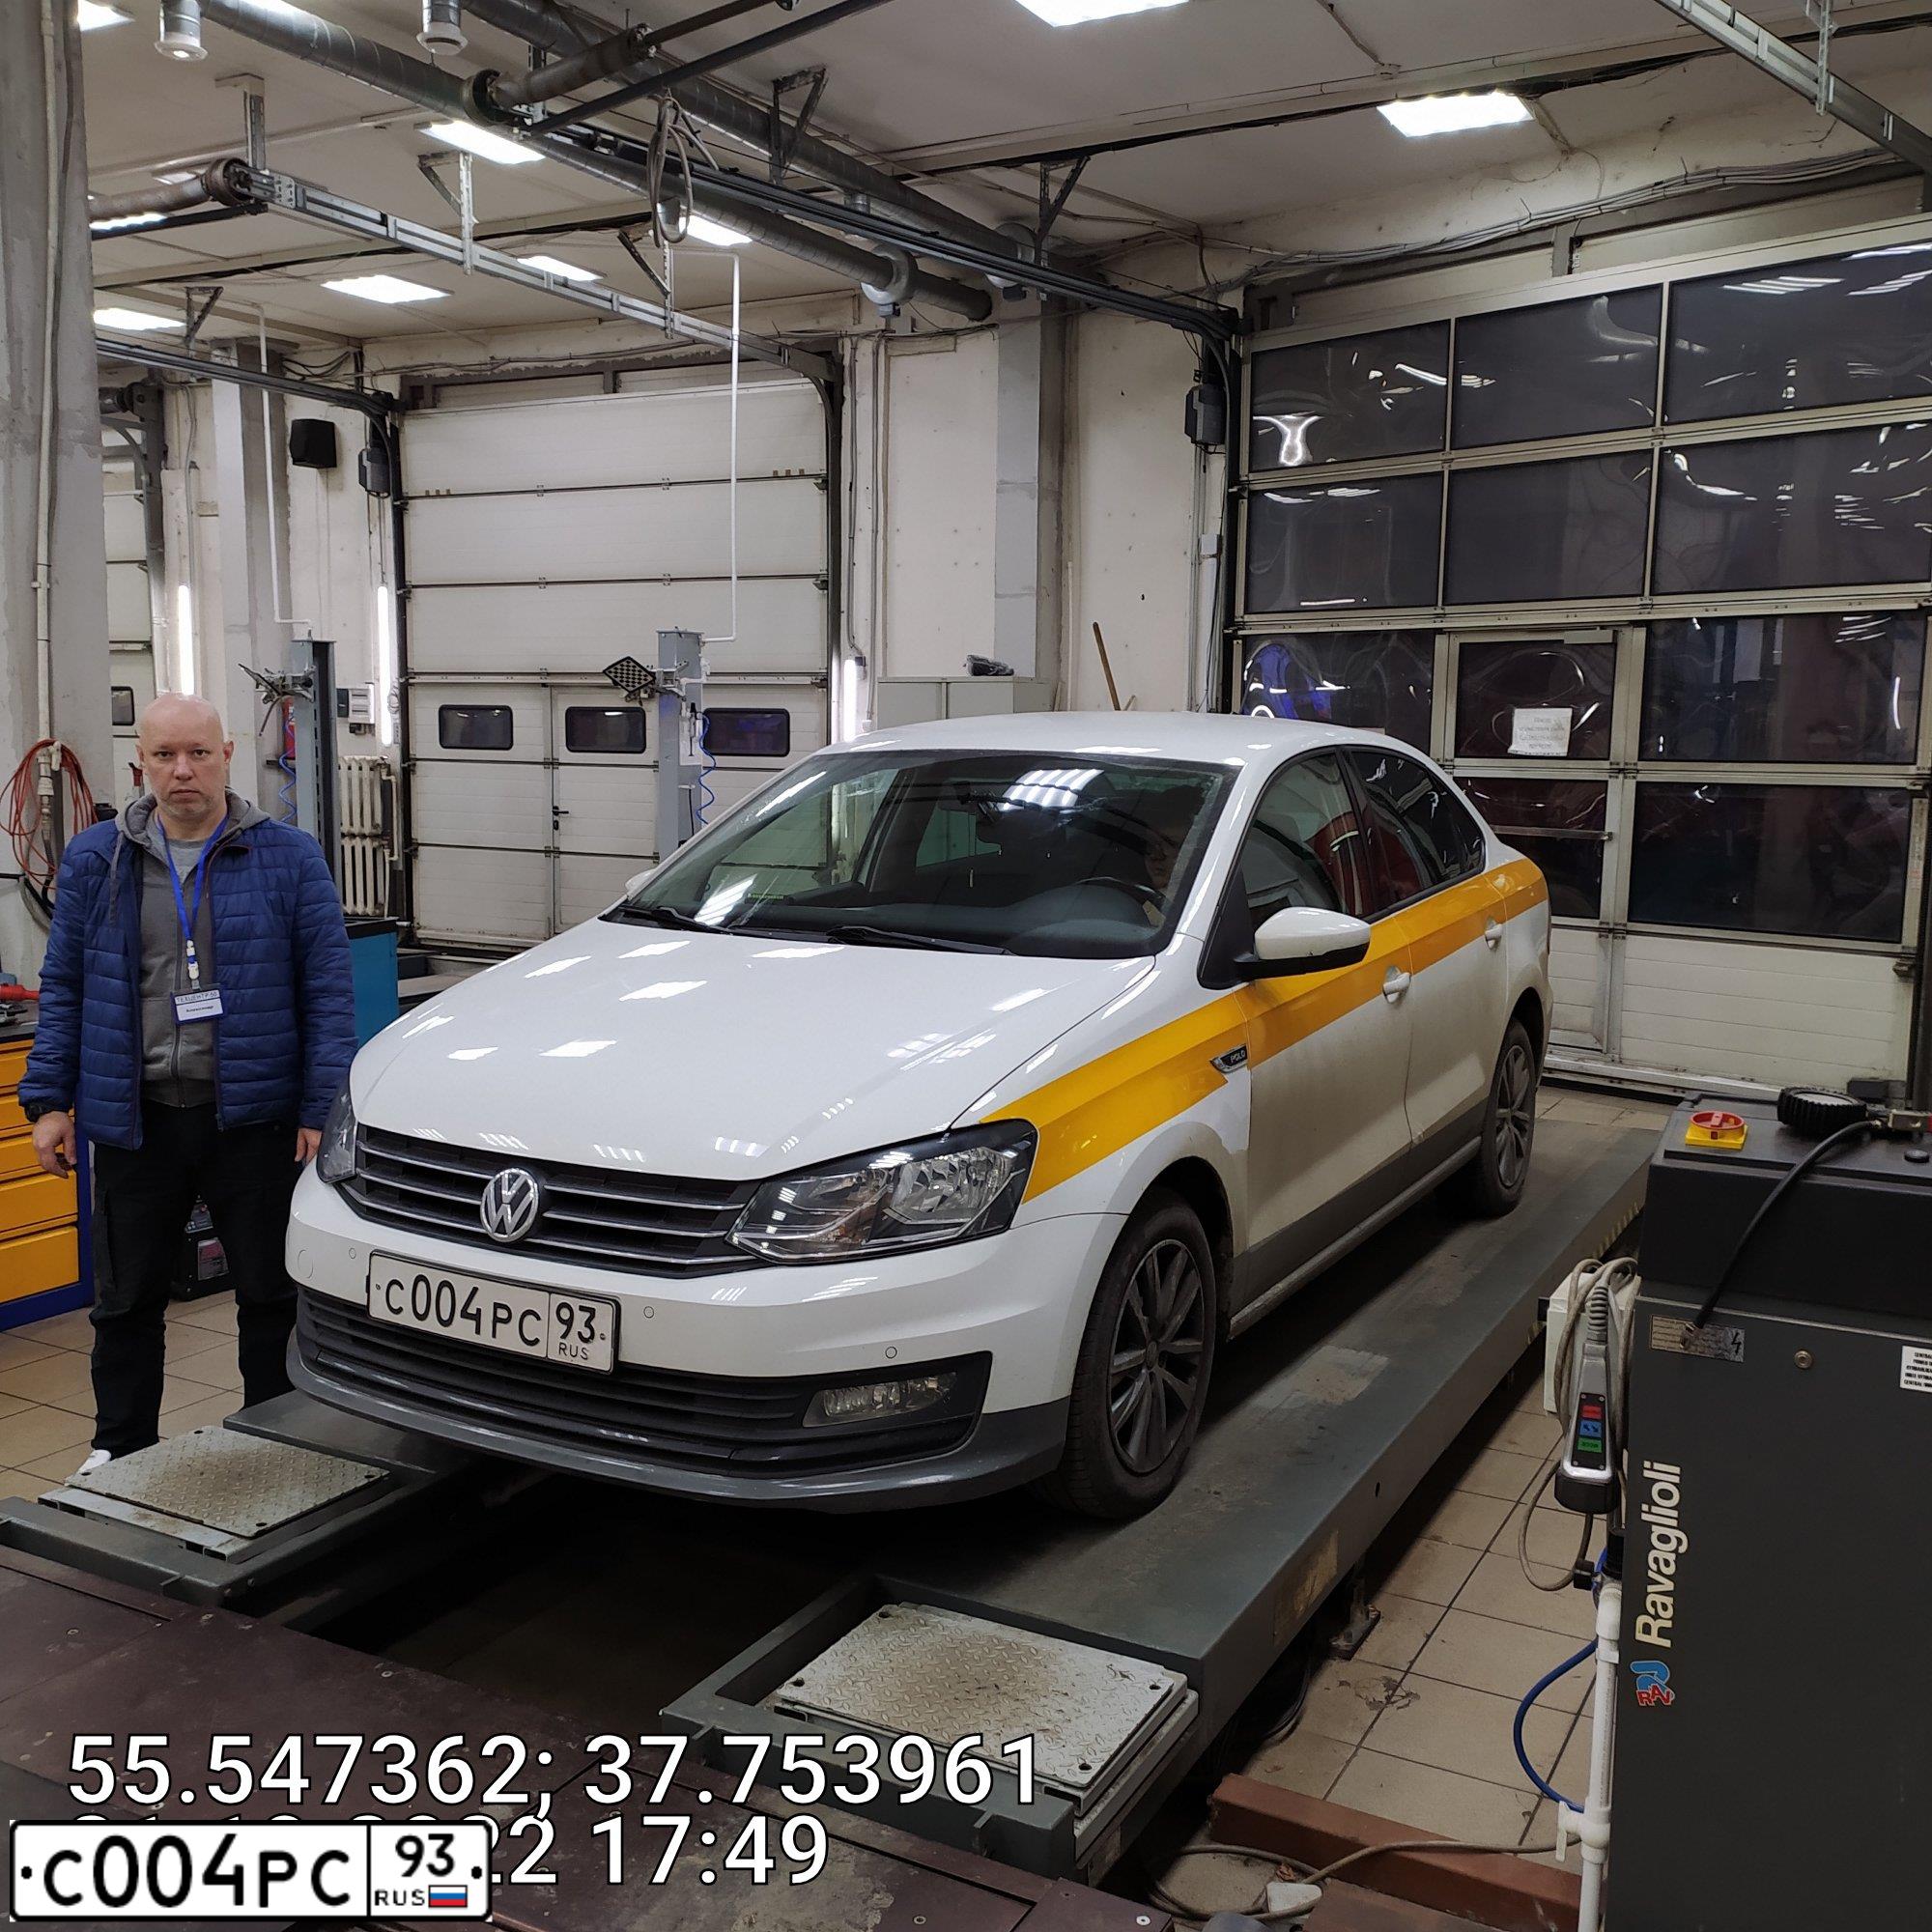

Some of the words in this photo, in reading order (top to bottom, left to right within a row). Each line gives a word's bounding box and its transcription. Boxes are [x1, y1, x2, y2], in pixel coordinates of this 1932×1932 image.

[385, 1274, 542, 1347] С004РС
[555, 1302, 596, 1344] 93
[557, 1342, 589, 1360] RUS
[1635, 1461, 1689, 1648] Ravaglioli
